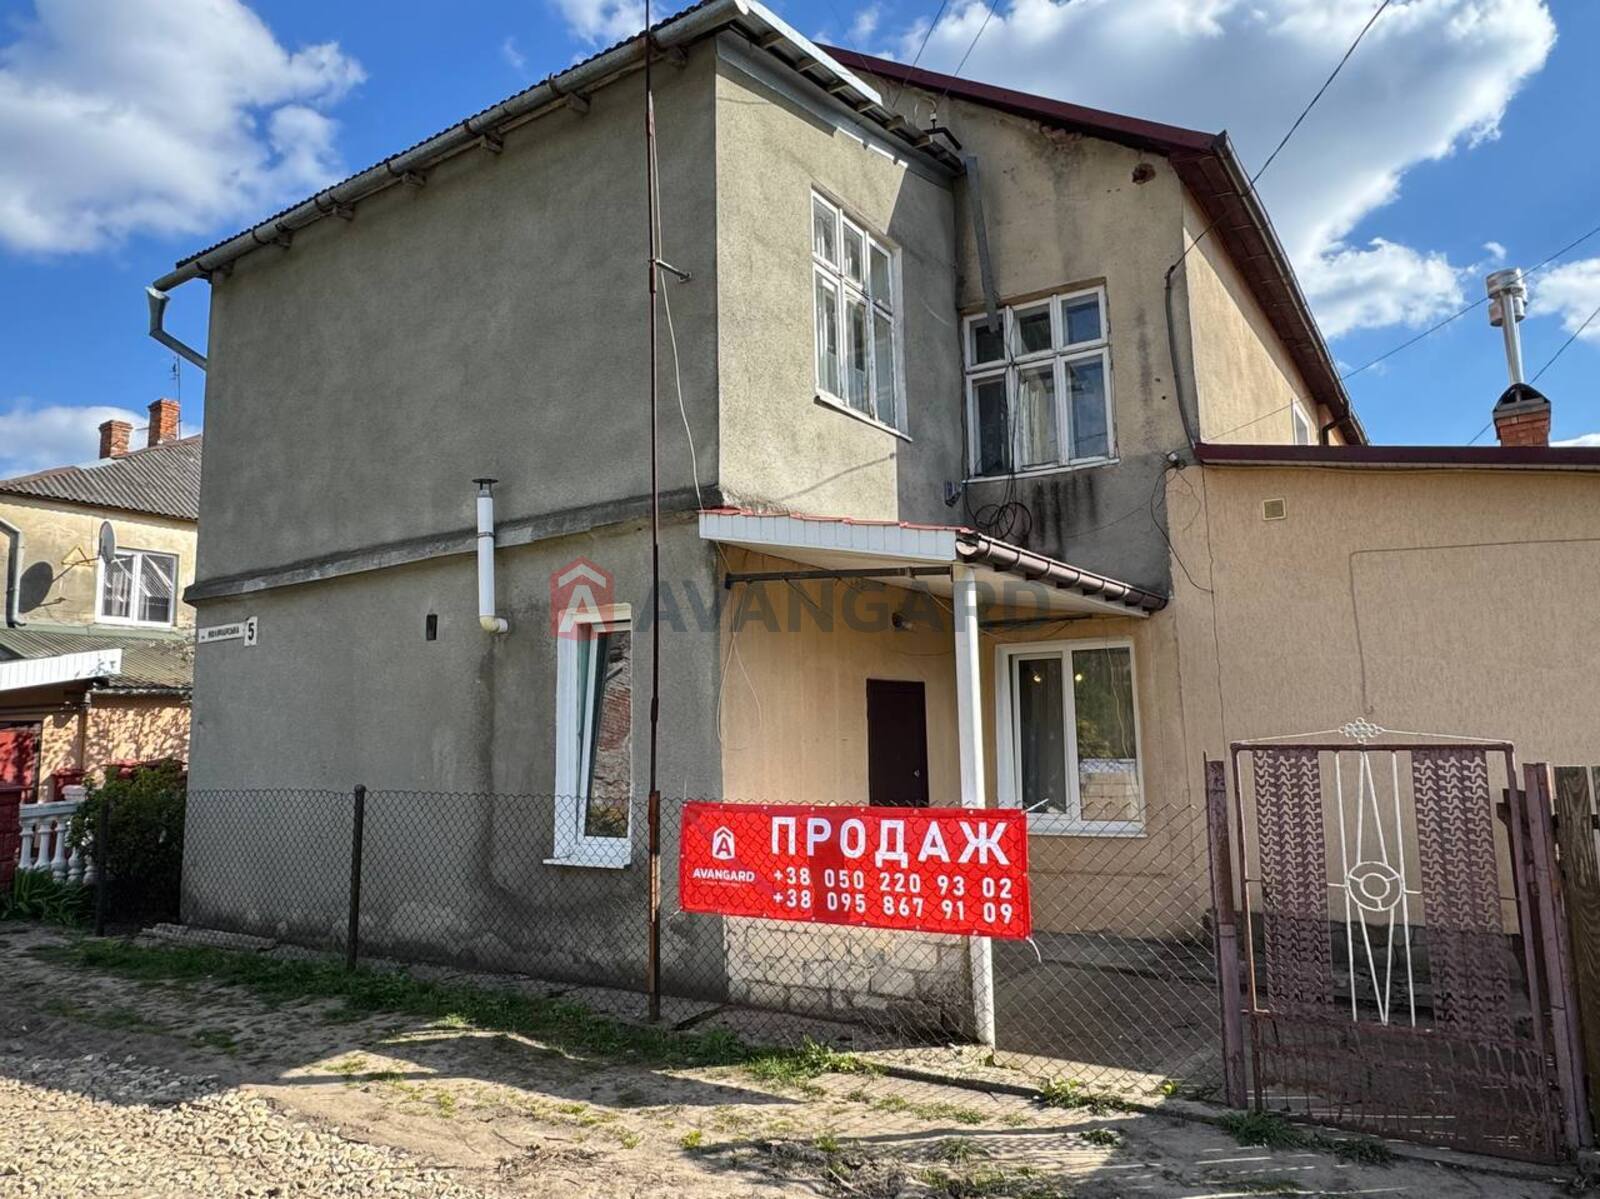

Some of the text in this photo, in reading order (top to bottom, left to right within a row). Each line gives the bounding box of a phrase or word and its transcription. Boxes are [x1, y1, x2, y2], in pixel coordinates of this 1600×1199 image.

[247, 622, 255, 641] 5
[771, 816, 1010, 868] ПРОДАЖ
[692, 868, 755, 883] AVANGARD
[773, 867, 1013, 899] +38 050 220 93 02
[773, 890, 1013, 924] +38 095 867 91 09
